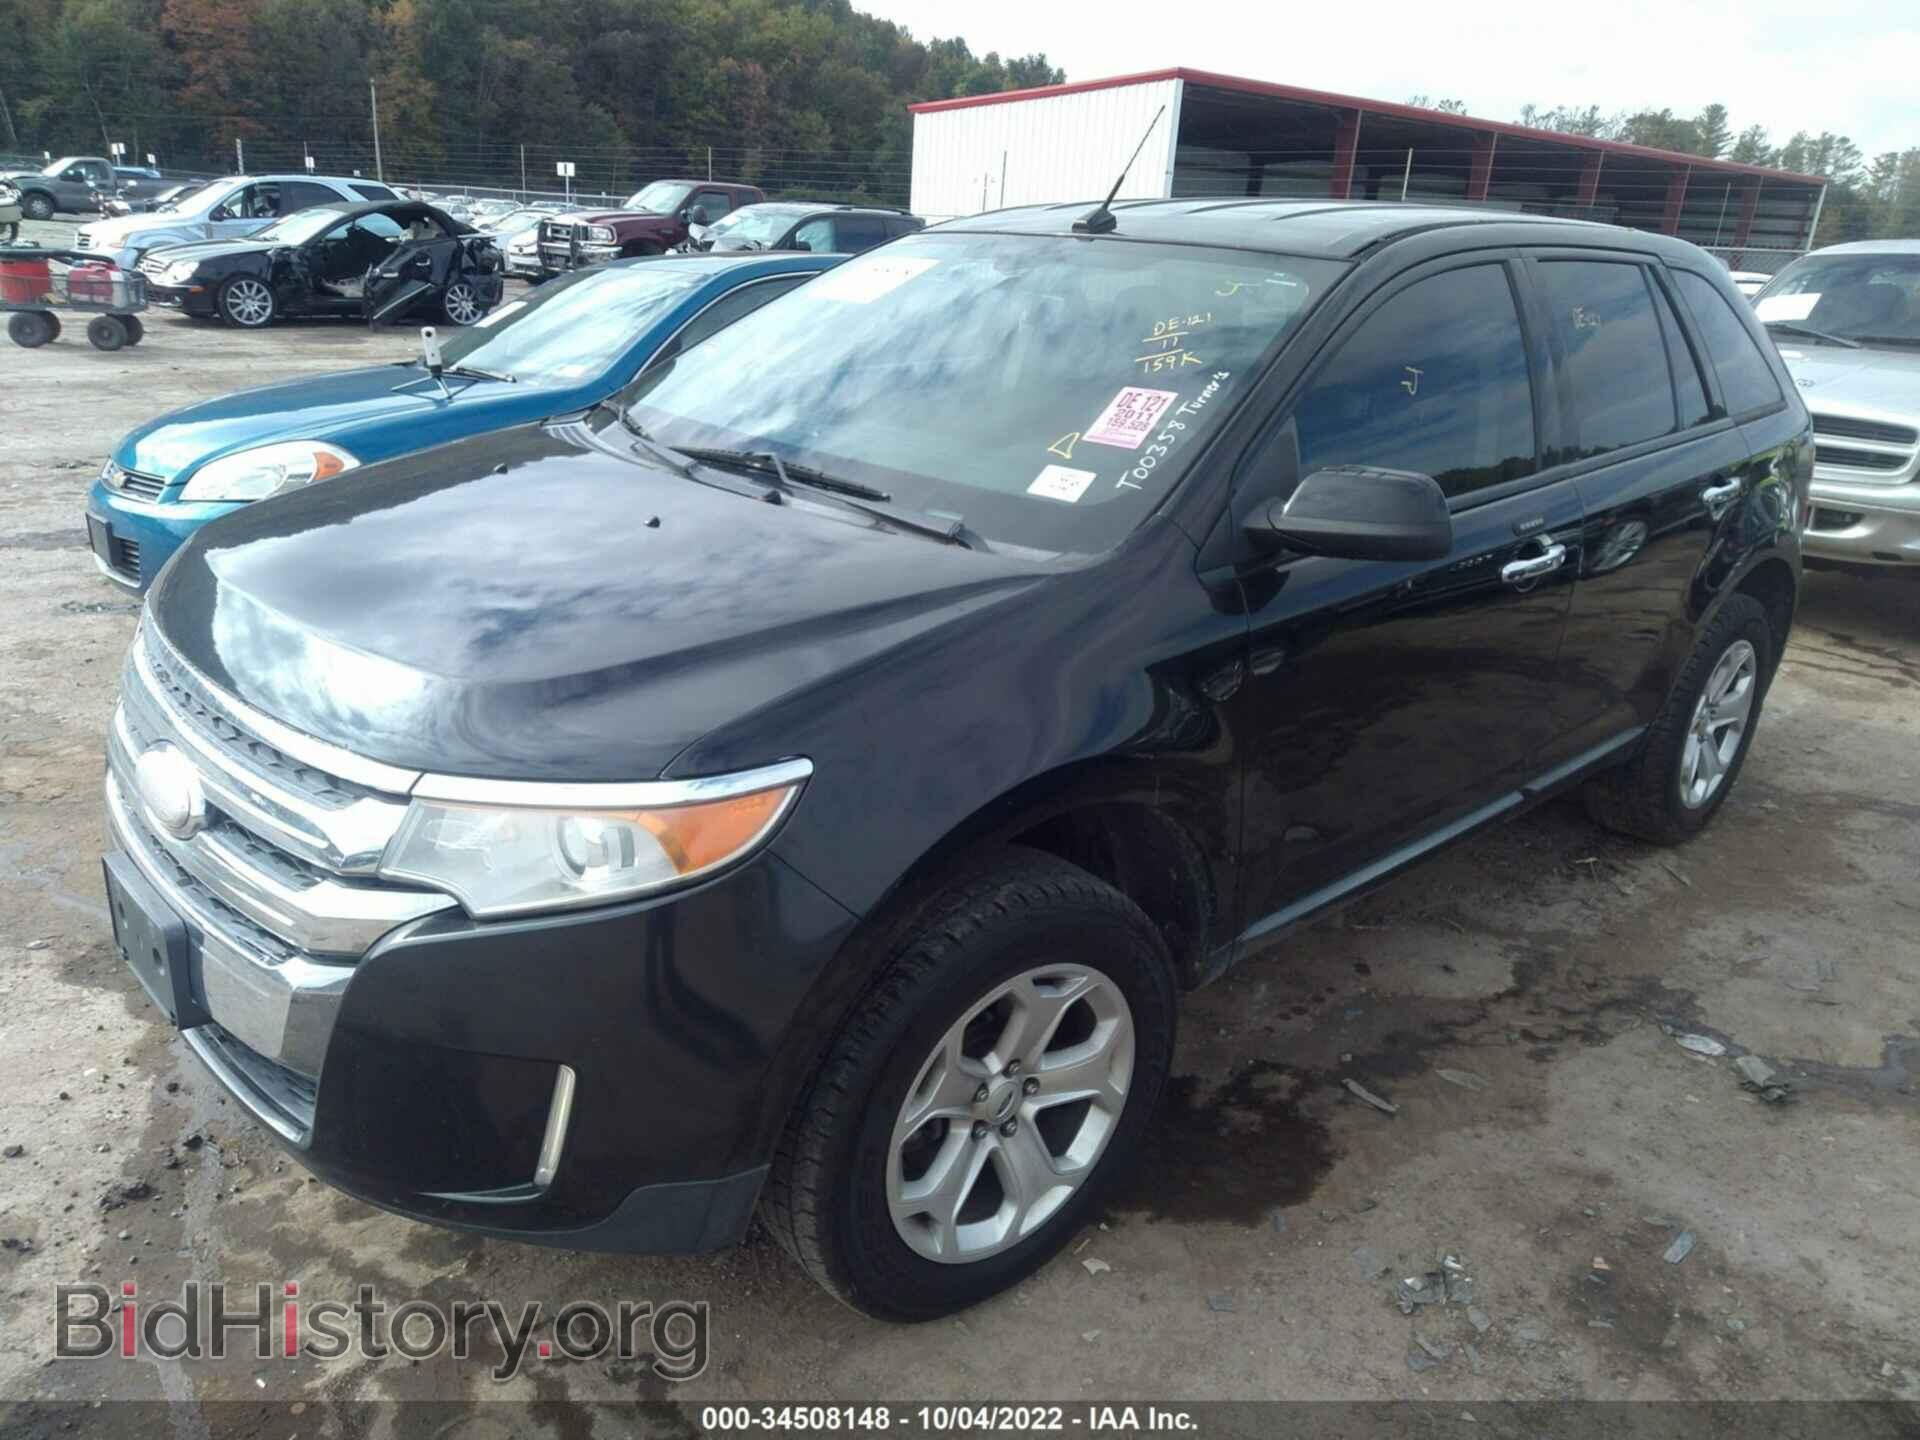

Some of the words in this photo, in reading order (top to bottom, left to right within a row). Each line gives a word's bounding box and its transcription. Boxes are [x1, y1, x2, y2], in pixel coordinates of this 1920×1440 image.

[1144, 352, 1203, 373] 159K
[1116, 391, 1143, 409] DE
[1140, 395, 1169, 413] 121
[1114, 408, 1154, 422] 2011
